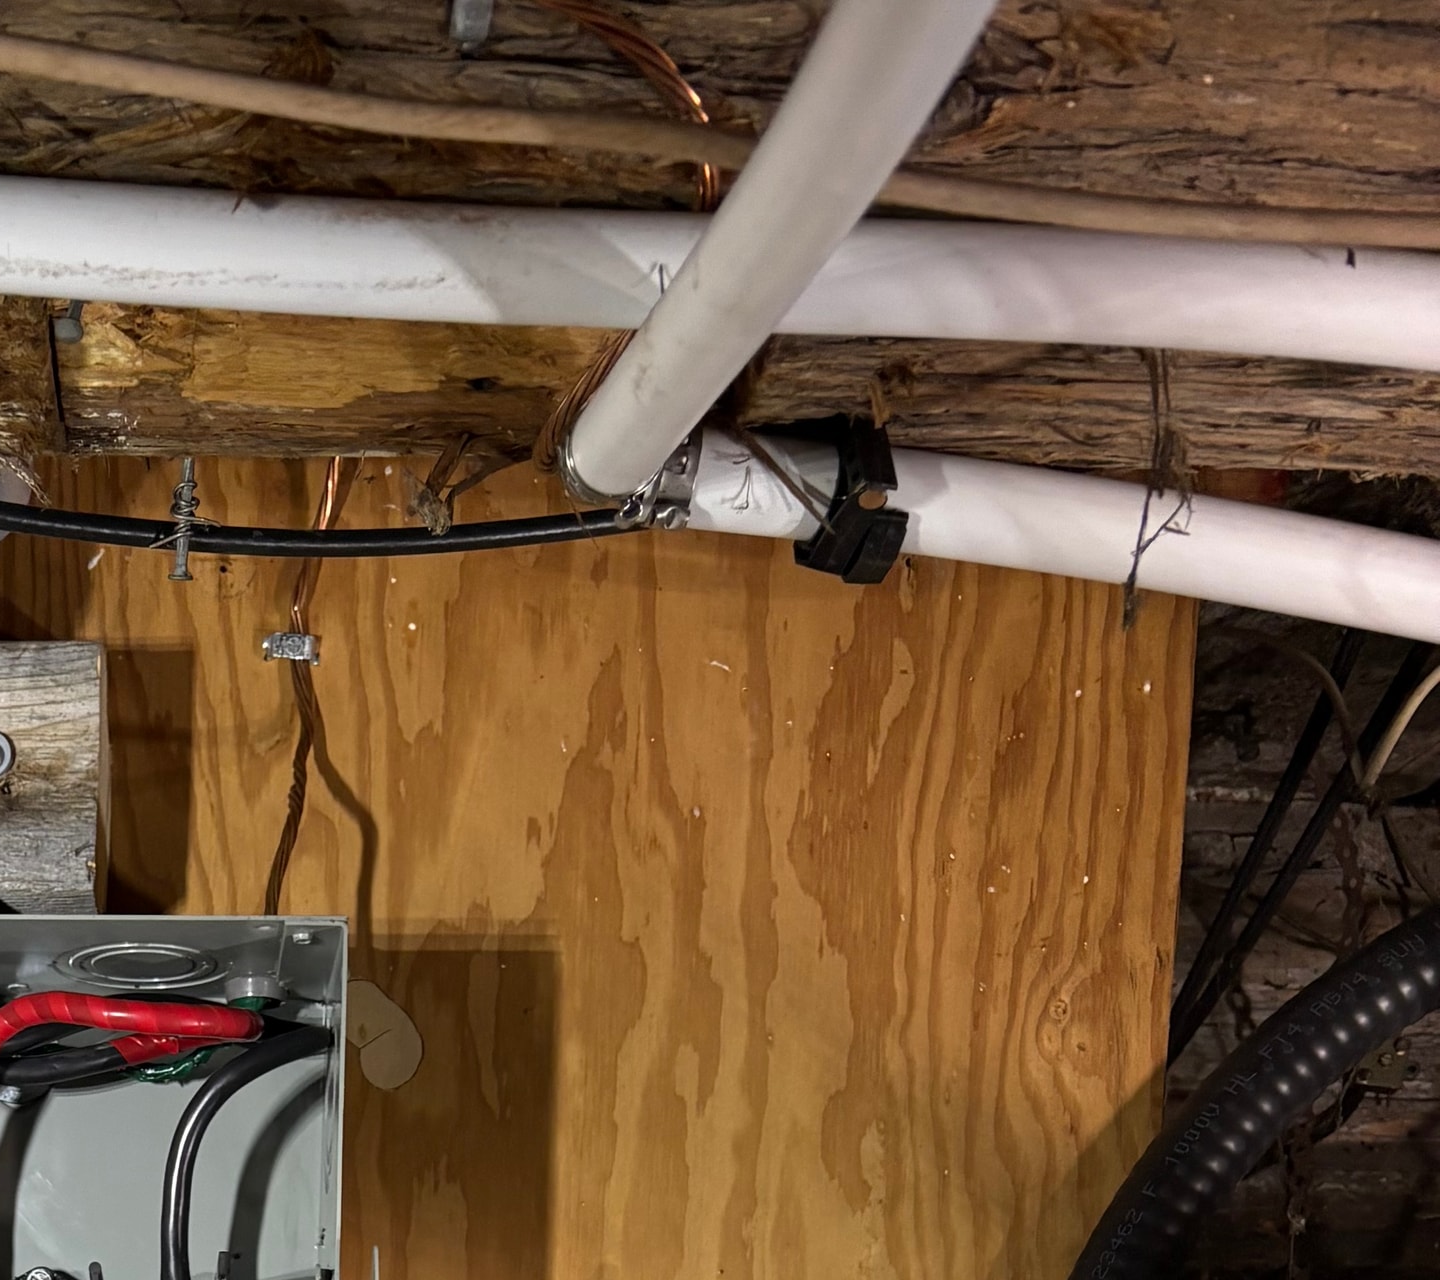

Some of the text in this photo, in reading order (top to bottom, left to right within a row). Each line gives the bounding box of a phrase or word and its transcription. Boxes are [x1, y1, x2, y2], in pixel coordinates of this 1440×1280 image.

[1165, 1102, 1220, 1166] 1000V
[1224, 1071, 1258, 1096] HL
[1257, 1022, 1303, 1060] FT4
[1309, 971, 1368, 1018] AG14
[1377, 934, 1426, 970] SUN
